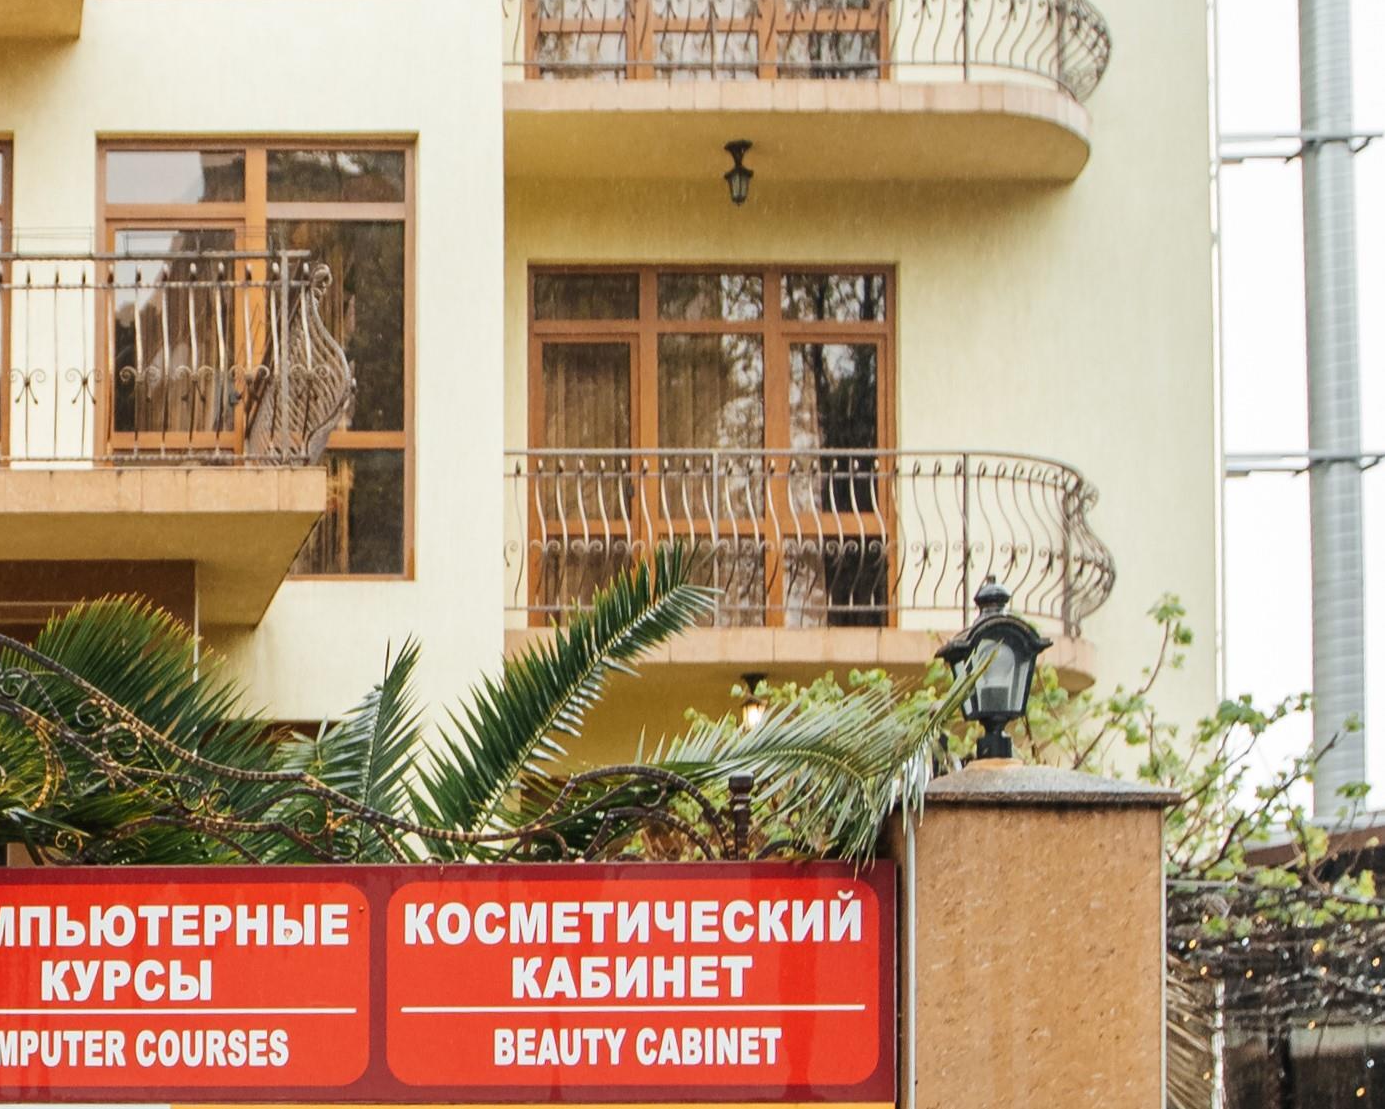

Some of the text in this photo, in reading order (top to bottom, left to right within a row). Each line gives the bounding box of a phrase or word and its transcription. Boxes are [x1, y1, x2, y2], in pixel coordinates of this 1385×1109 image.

[404, 890, 862, 945] КОСМЕТИЧЕСКИЙ
[41, 959, 212, 1002] КУРСЫ
[512, 955, 753, 999] КАБИНЕТ
[135, 1029, 289, 1068] COURSES
[494, 1027, 782, 1066] BEAUTY CABINET
